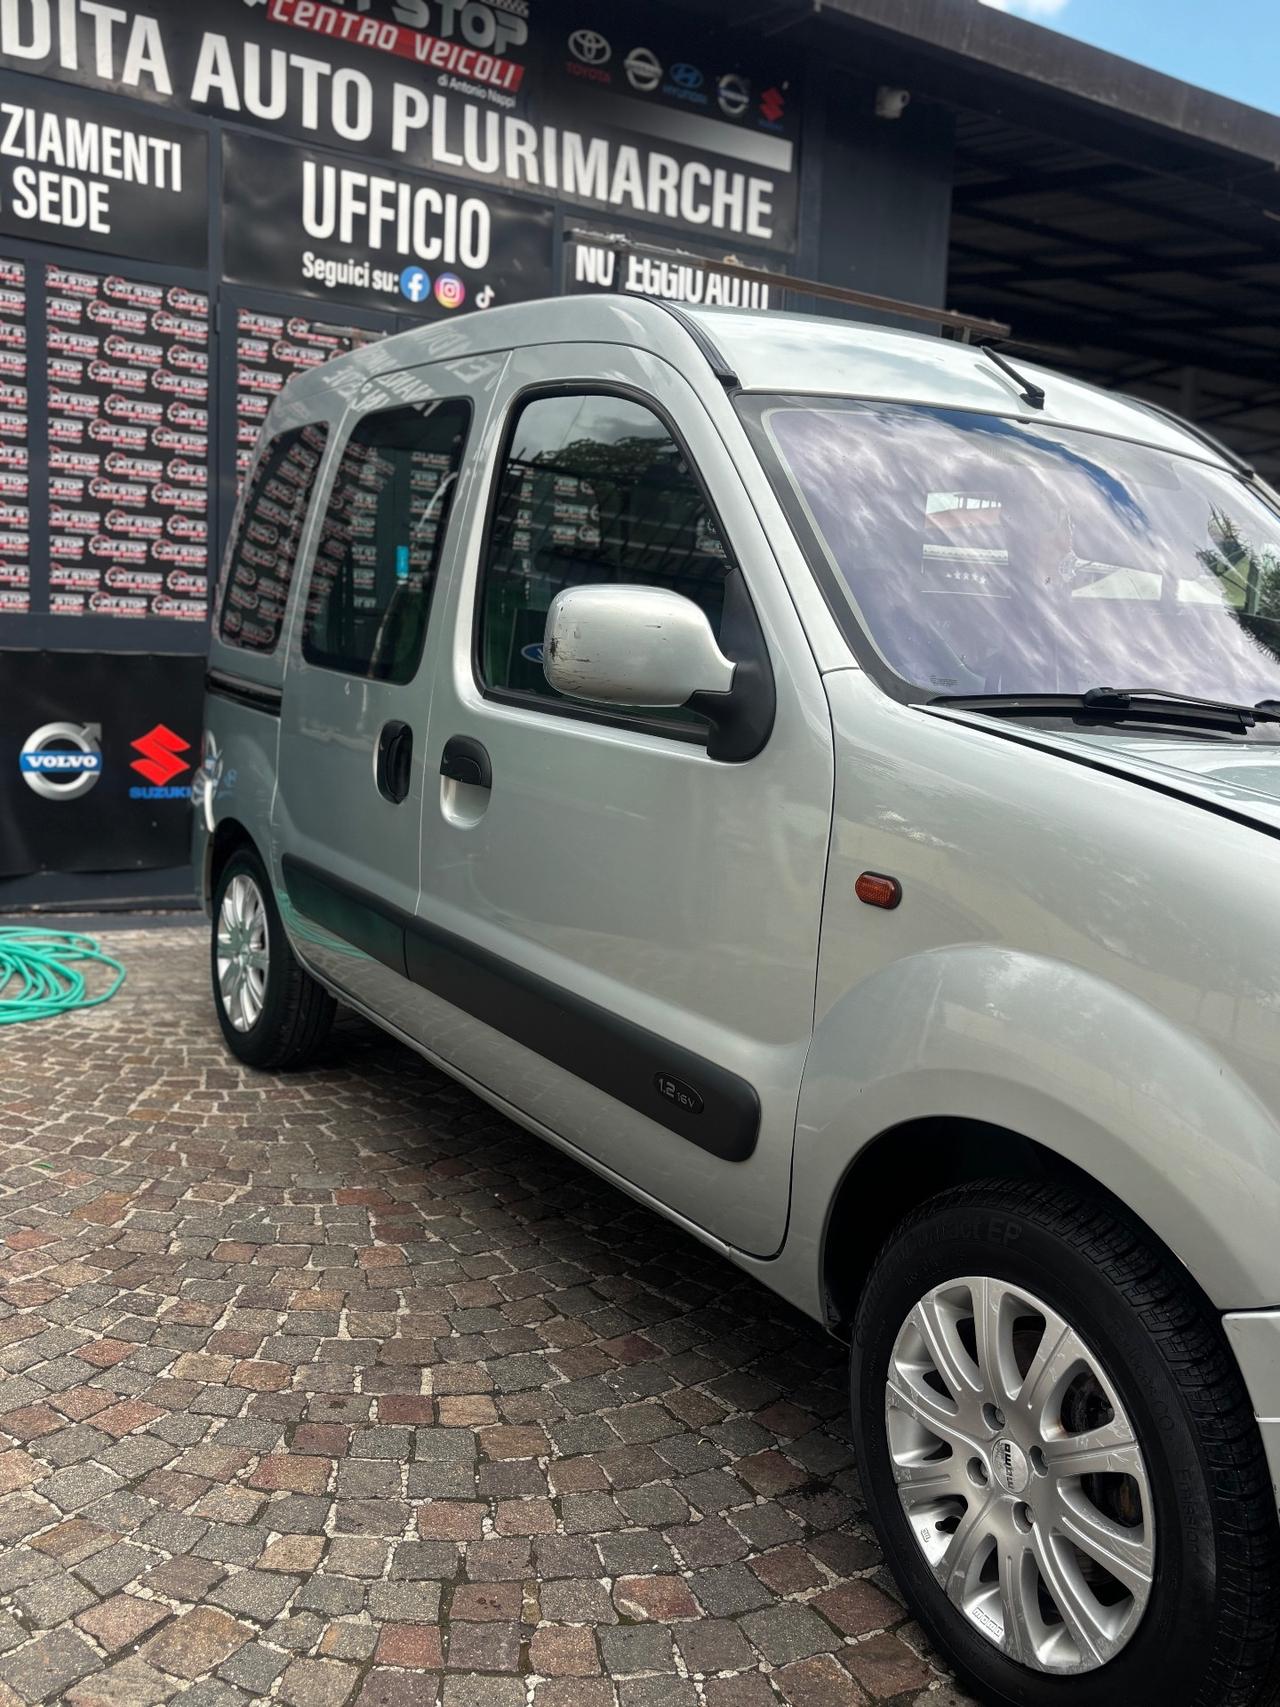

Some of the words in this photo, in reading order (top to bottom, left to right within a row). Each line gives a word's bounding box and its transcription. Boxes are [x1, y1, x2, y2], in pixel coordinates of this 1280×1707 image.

[1, 0, 173, 96] DITA
[191, 31, 373, 142] AUTO
[391, 82, 774, 240] PLURIMARCHE
[0, 104, 182, 192] ZIAMENTI
[12, 165, 111, 234] SEDE
[302, 160, 491, 270] UFFICIO
[302, 251, 370, 289] Seguici
[373, 273, 400, 293] su:
[26, 755, 98, 768] VOLVO
[129, 786, 193, 799] SUZUKI
[658, 1078, 676, 1099] 1.2
